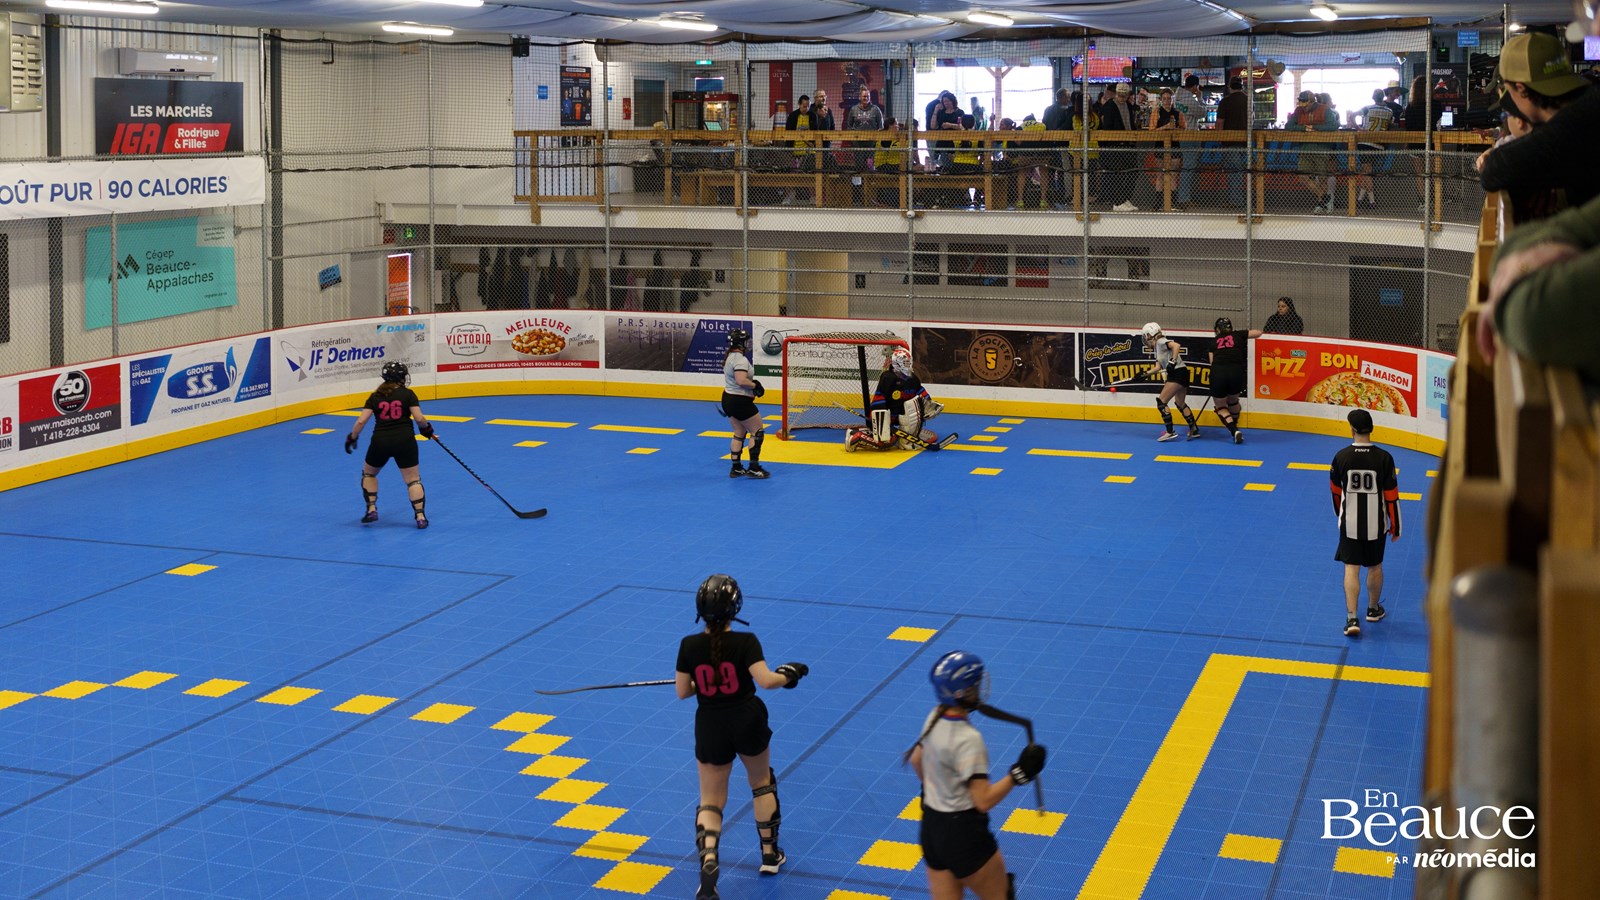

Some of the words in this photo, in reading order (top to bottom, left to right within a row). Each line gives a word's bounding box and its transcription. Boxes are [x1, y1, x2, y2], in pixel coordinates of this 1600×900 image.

[130, 105, 152, 118] LES
[155, 104, 213, 118] MARCHÉS
[110, 123, 161, 155] IGA
[177, 128, 220, 140] Rodrigue
[174, 139, 181, 149] &
[182, 139, 207, 149] Filles
[50, 182, 93, 202] PUR
[108, 180, 133, 199] 90
[138, 176, 228, 197] CALORIES
[145, 249, 175, 261] Cégep
[146, 260, 197, 275] Beauce-
[146, 271, 214, 293] Appalaches
[386, 323, 425, 333] DAIKIN
[505, 317, 572, 336] MEILLEURE
[618, 318, 648, 328] P.R.S.
[653, 319, 696, 330] Jacques
[700, 321, 730, 331] Nolet
[311, 337, 351, 349] Réfrigération
[446, 333, 492, 346] VICTORIA
[1216, 335, 1234, 349] 23
[308, 349, 324, 371] JF
[327, 345, 385, 364] Demers
[972, 347, 979, 359] LA
[131, 363, 140, 371] LES
[131, 366, 166, 379] SPÉCIALISTES
[186, 365, 214, 376] GROUPE
[458, 362, 497, 370] SAINT-GEORGES
[1261, 356, 1307, 378] PIZZ
[1320, 352, 1359, 370] BON
[1363, 363, 1371, 376] À
[1373, 368, 1409, 388] MAISON
[60, 378, 84, 396] 50
[131, 379, 140, 387] EN
[140, 377, 151, 385] GAZ
[186, 372, 218, 397] S.S.
[1433, 376, 1446, 389] FAIS
[171, 404, 193, 414] PROPANE
[211, 397, 232, 407] NATUREL
[378, 400, 402, 420] 26
[30, 409, 112, 433] www.maisoncrb.com
[49, 422, 100, 441] 418-228-8304
[896, 429, 929, 448] CCM
[1351, 472, 1373, 491] 90
